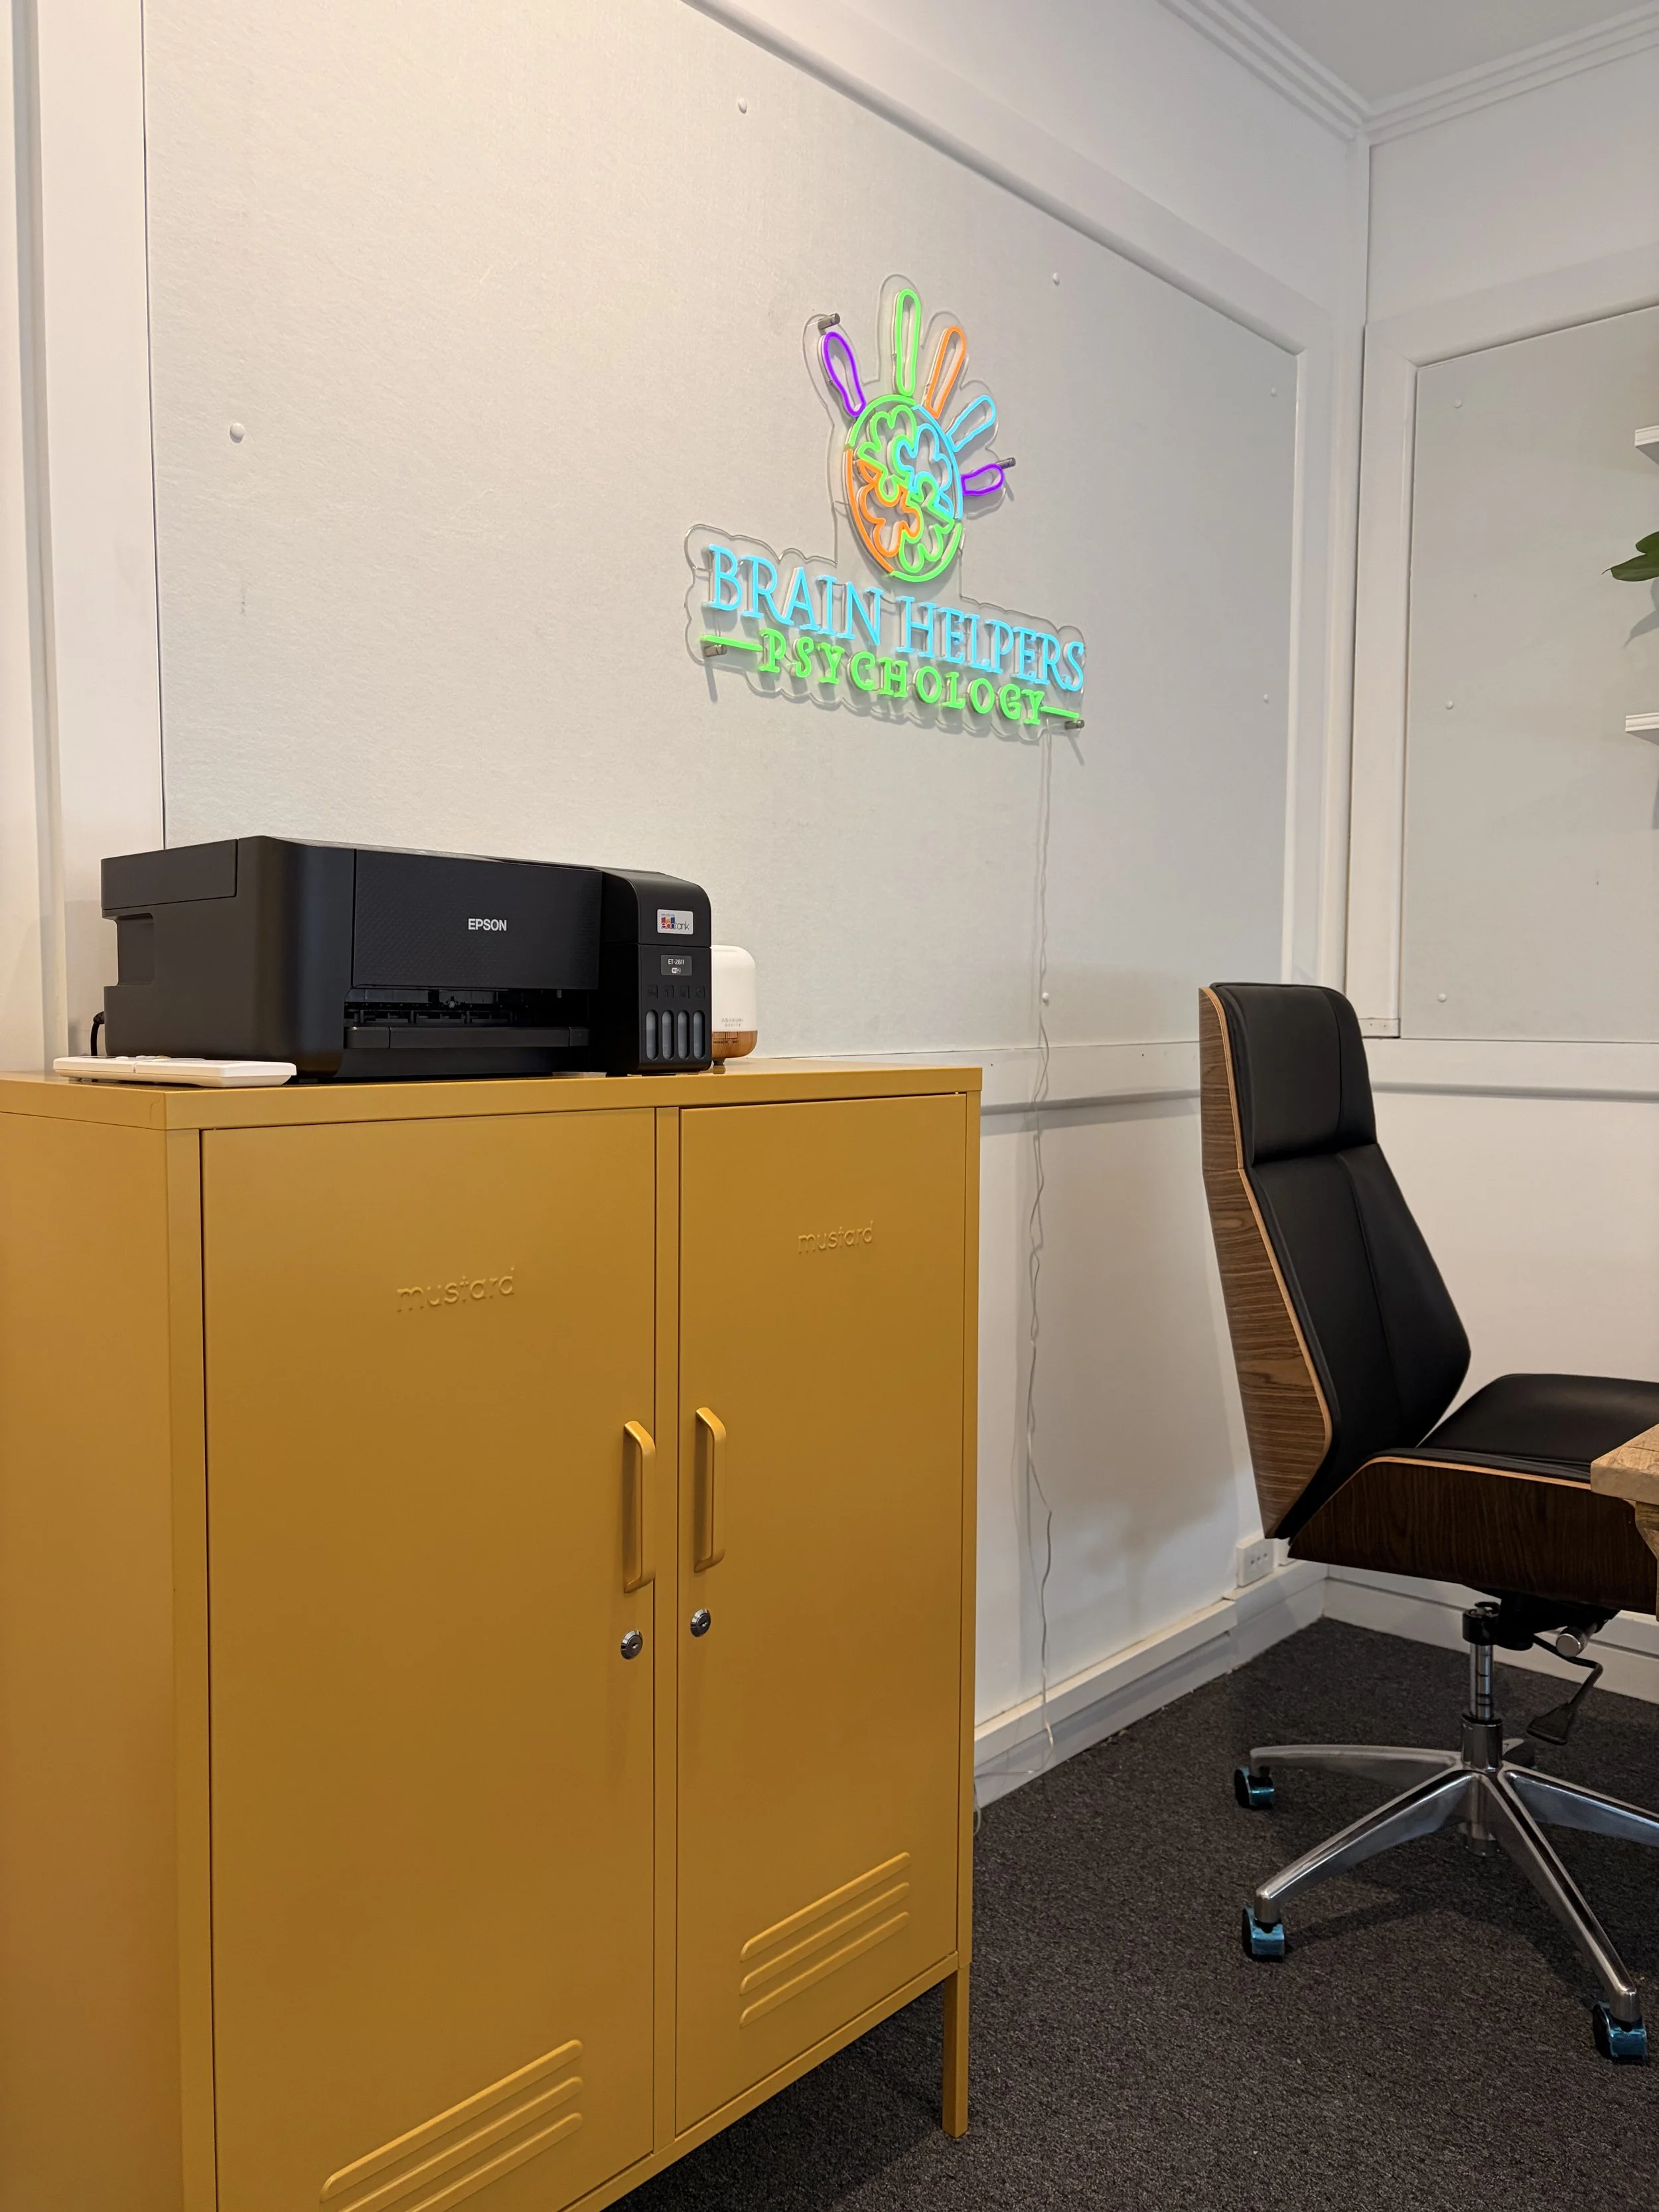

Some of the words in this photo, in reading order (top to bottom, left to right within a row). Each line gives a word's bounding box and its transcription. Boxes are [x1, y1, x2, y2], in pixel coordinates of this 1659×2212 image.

[703, 543, 884, 646] BRAIN
[893, 595, 1084, 692] HELPERS
[758, 627, 1045, 725] PSYCHOLOGY
[468, 918, 507, 931] EPSON
[798, 1220, 873, 1254] mustard
[397, 1267, 514, 1313] mustard
